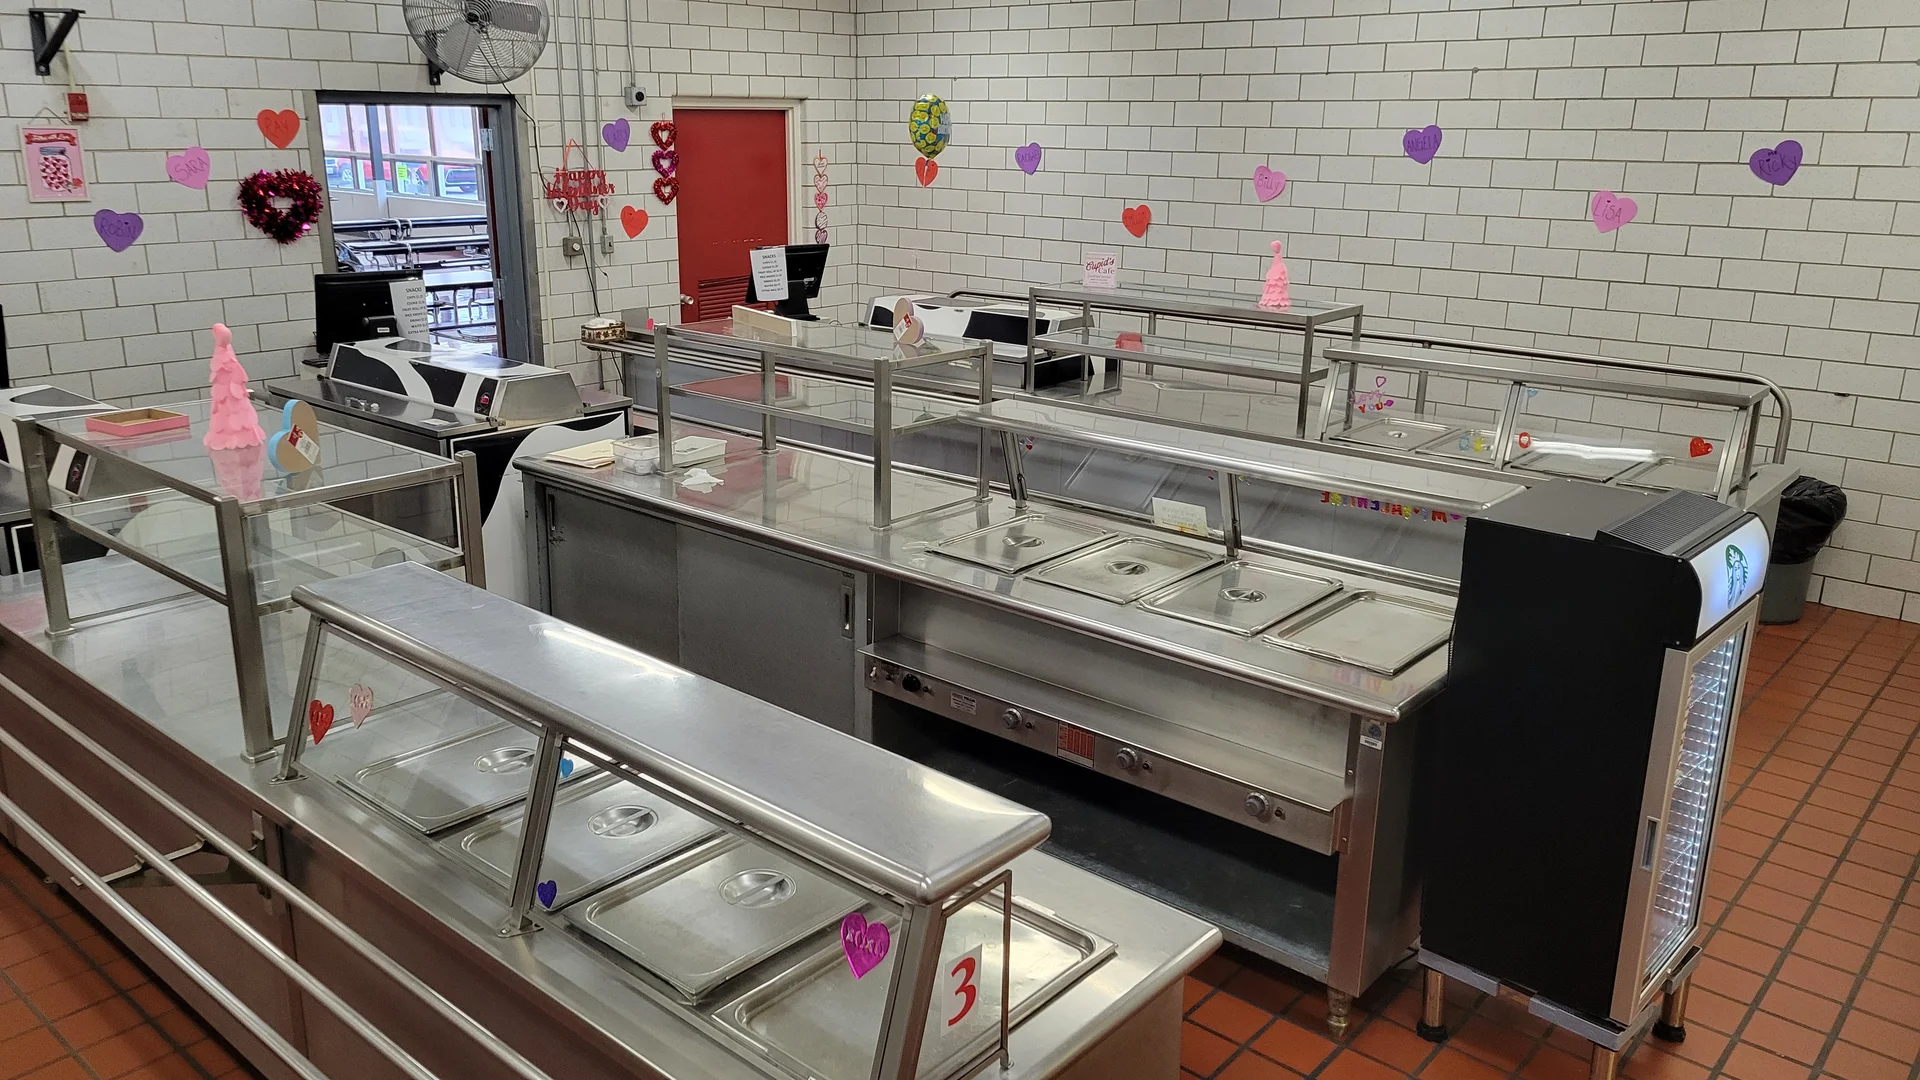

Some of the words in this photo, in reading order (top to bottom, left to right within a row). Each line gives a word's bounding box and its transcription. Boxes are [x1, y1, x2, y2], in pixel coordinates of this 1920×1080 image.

[1406, 133, 1441, 152] ANGELA
[174, 156, 209, 181] SARA
[569, 196, 601, 216] Day
[1085, 256, 1115, 272] Cupid's
[1357, 401, 1384, 414] YOU
[947, 956, 978, 1028] 3
